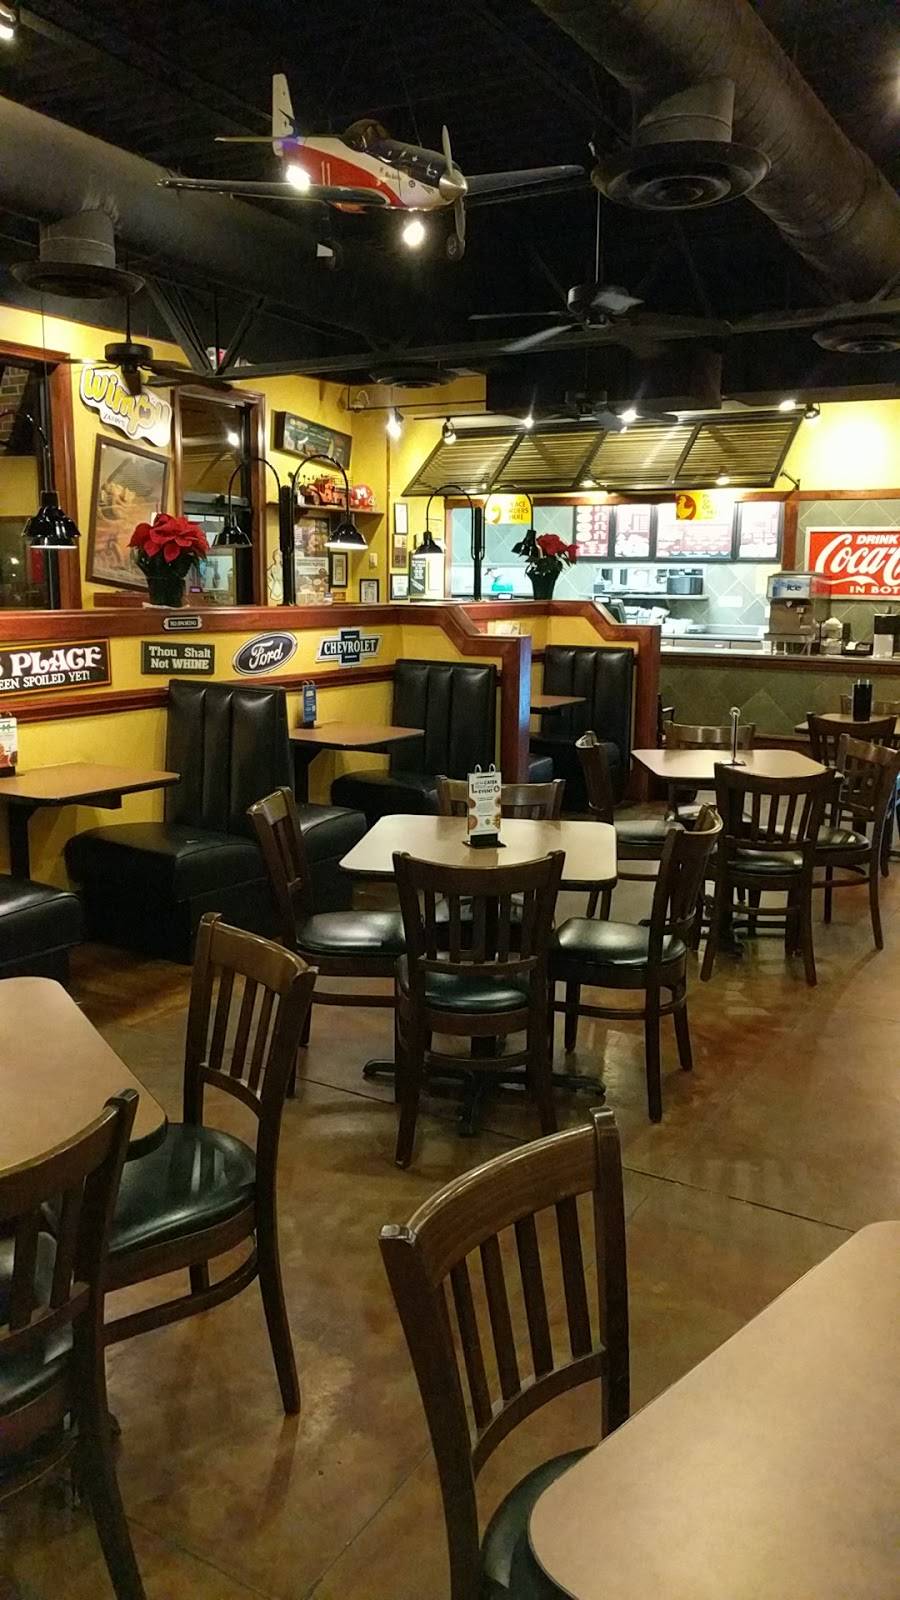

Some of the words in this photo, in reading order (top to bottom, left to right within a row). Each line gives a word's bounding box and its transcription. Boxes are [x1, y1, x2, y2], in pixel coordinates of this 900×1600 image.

[856, 534, 898, 545] DRINK
[849, 585, 865, 594] IN
[148, 645, 178, 657] Thou
[184, 647, 211, 658] Shalt
[248, 640, 284, 669] Ford
[324, 640, 376, 655] CHEVROLET
[10, 646, 103, 677] PLACE
[150, 658, 169, 669] Not
[171, 659, 210, 670] WHINE
[23, 673, 66, 688] SPOILED
[68, 671, 90, 682] YET!
